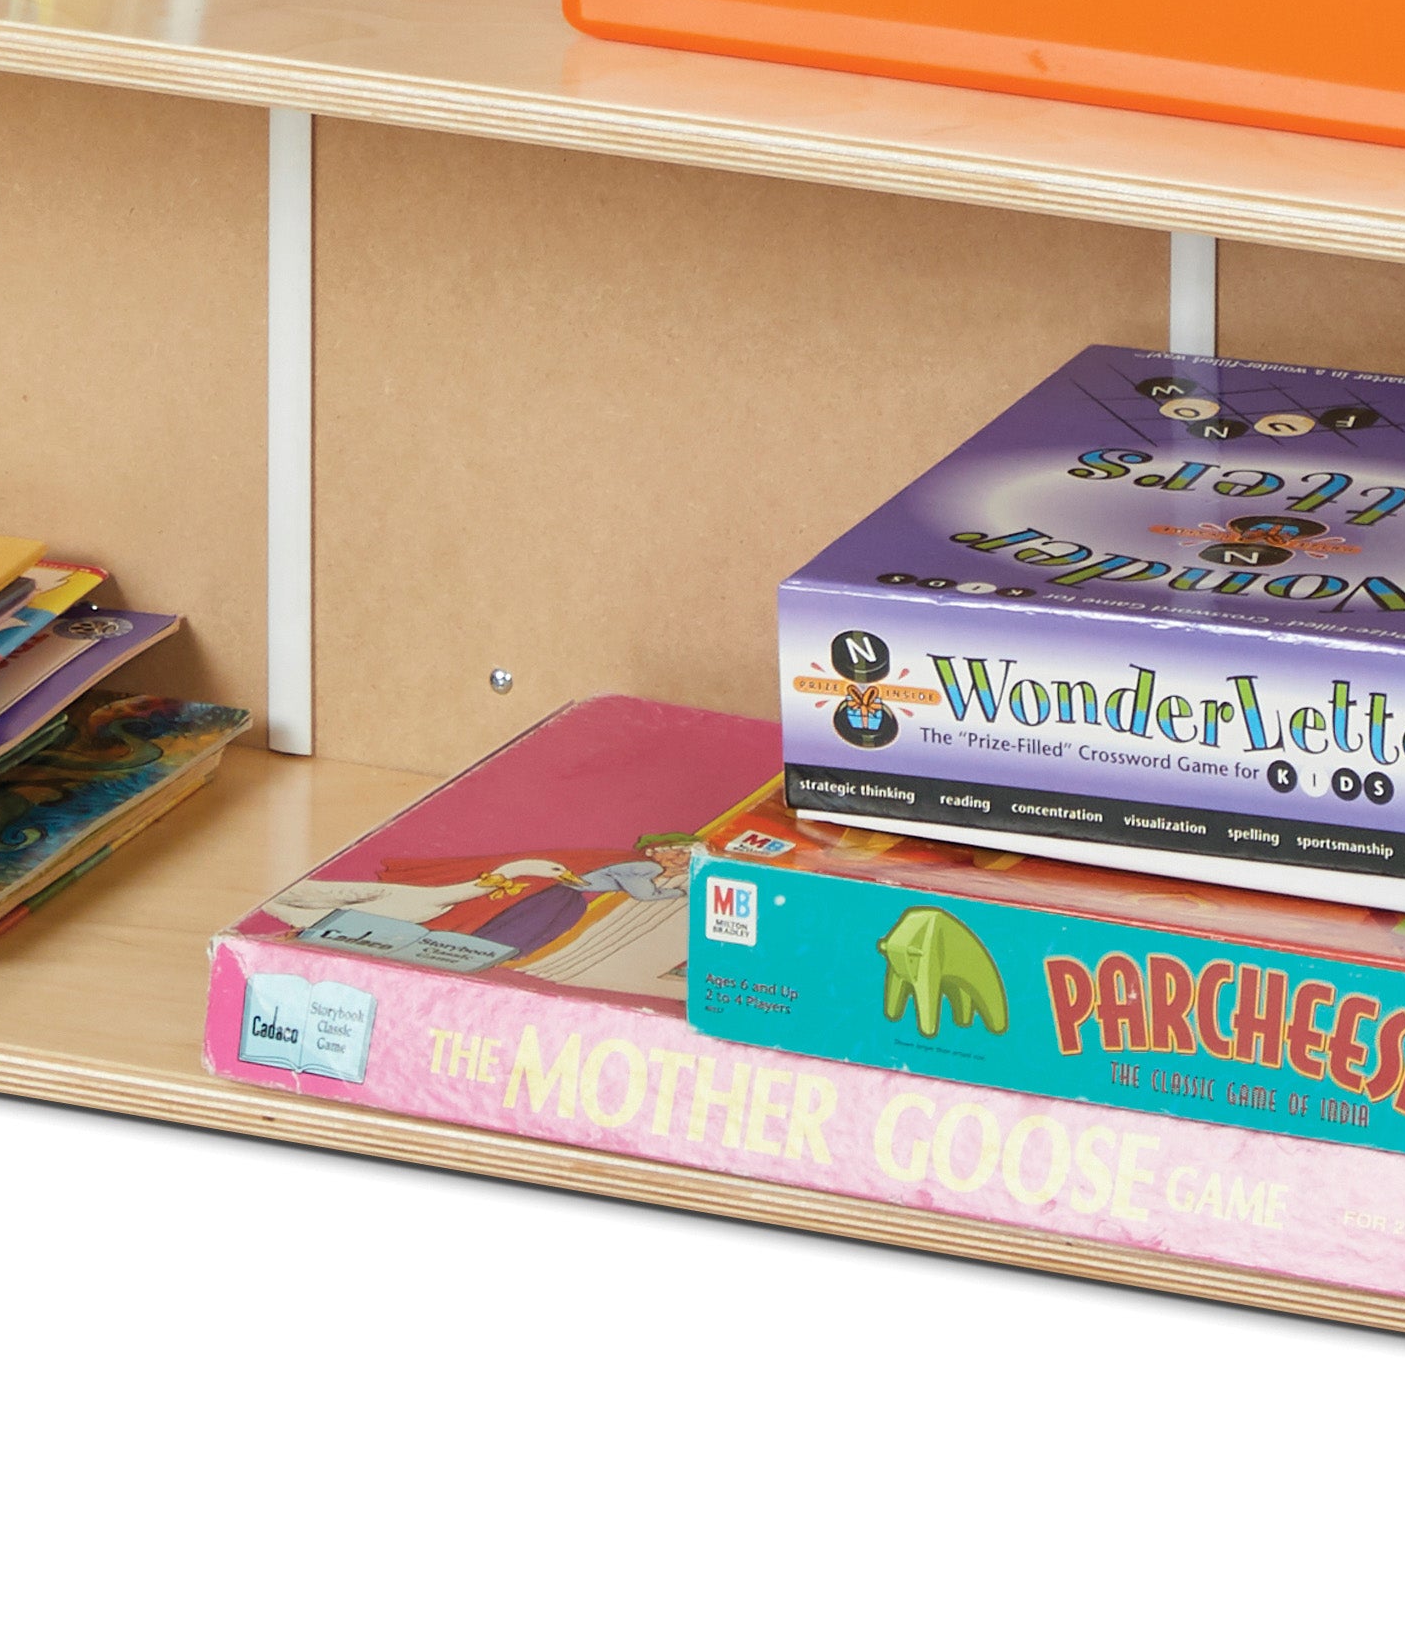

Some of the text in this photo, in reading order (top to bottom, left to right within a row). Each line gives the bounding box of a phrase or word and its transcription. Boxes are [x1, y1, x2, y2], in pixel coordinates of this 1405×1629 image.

[919, 727, 1171, 771] The Crossword
[799, 778, 856, 796] strategic
[860, 783, 916, 804] thinking
[939, 793, 991, 813] reading
[1011, 801, 1104, 823] concentration
[1123, 815, 1207, 835] visualization
[1227, 827, 1280, 846] spelling
[1296, 834, 1394, 859] sportsmanship
[705, 973, 738, 988] Ages
[252, 1006, 298, 1044] Cadaco
[310, 1002, 364, 1023] Storybook
[746, 997, 791, 1015] Players
[317, 1021, 352, 1038] Classic
[1151, 1068, 1371, 1128] CLASSIC OF INDIA
[428, 1025, 504, 1087] THE
[501, 1023, 837, 1168] MOTHER
[872, 1091, 1161, 1225] GOOSE
[1165, 1163, 1289, 1232] GAME
